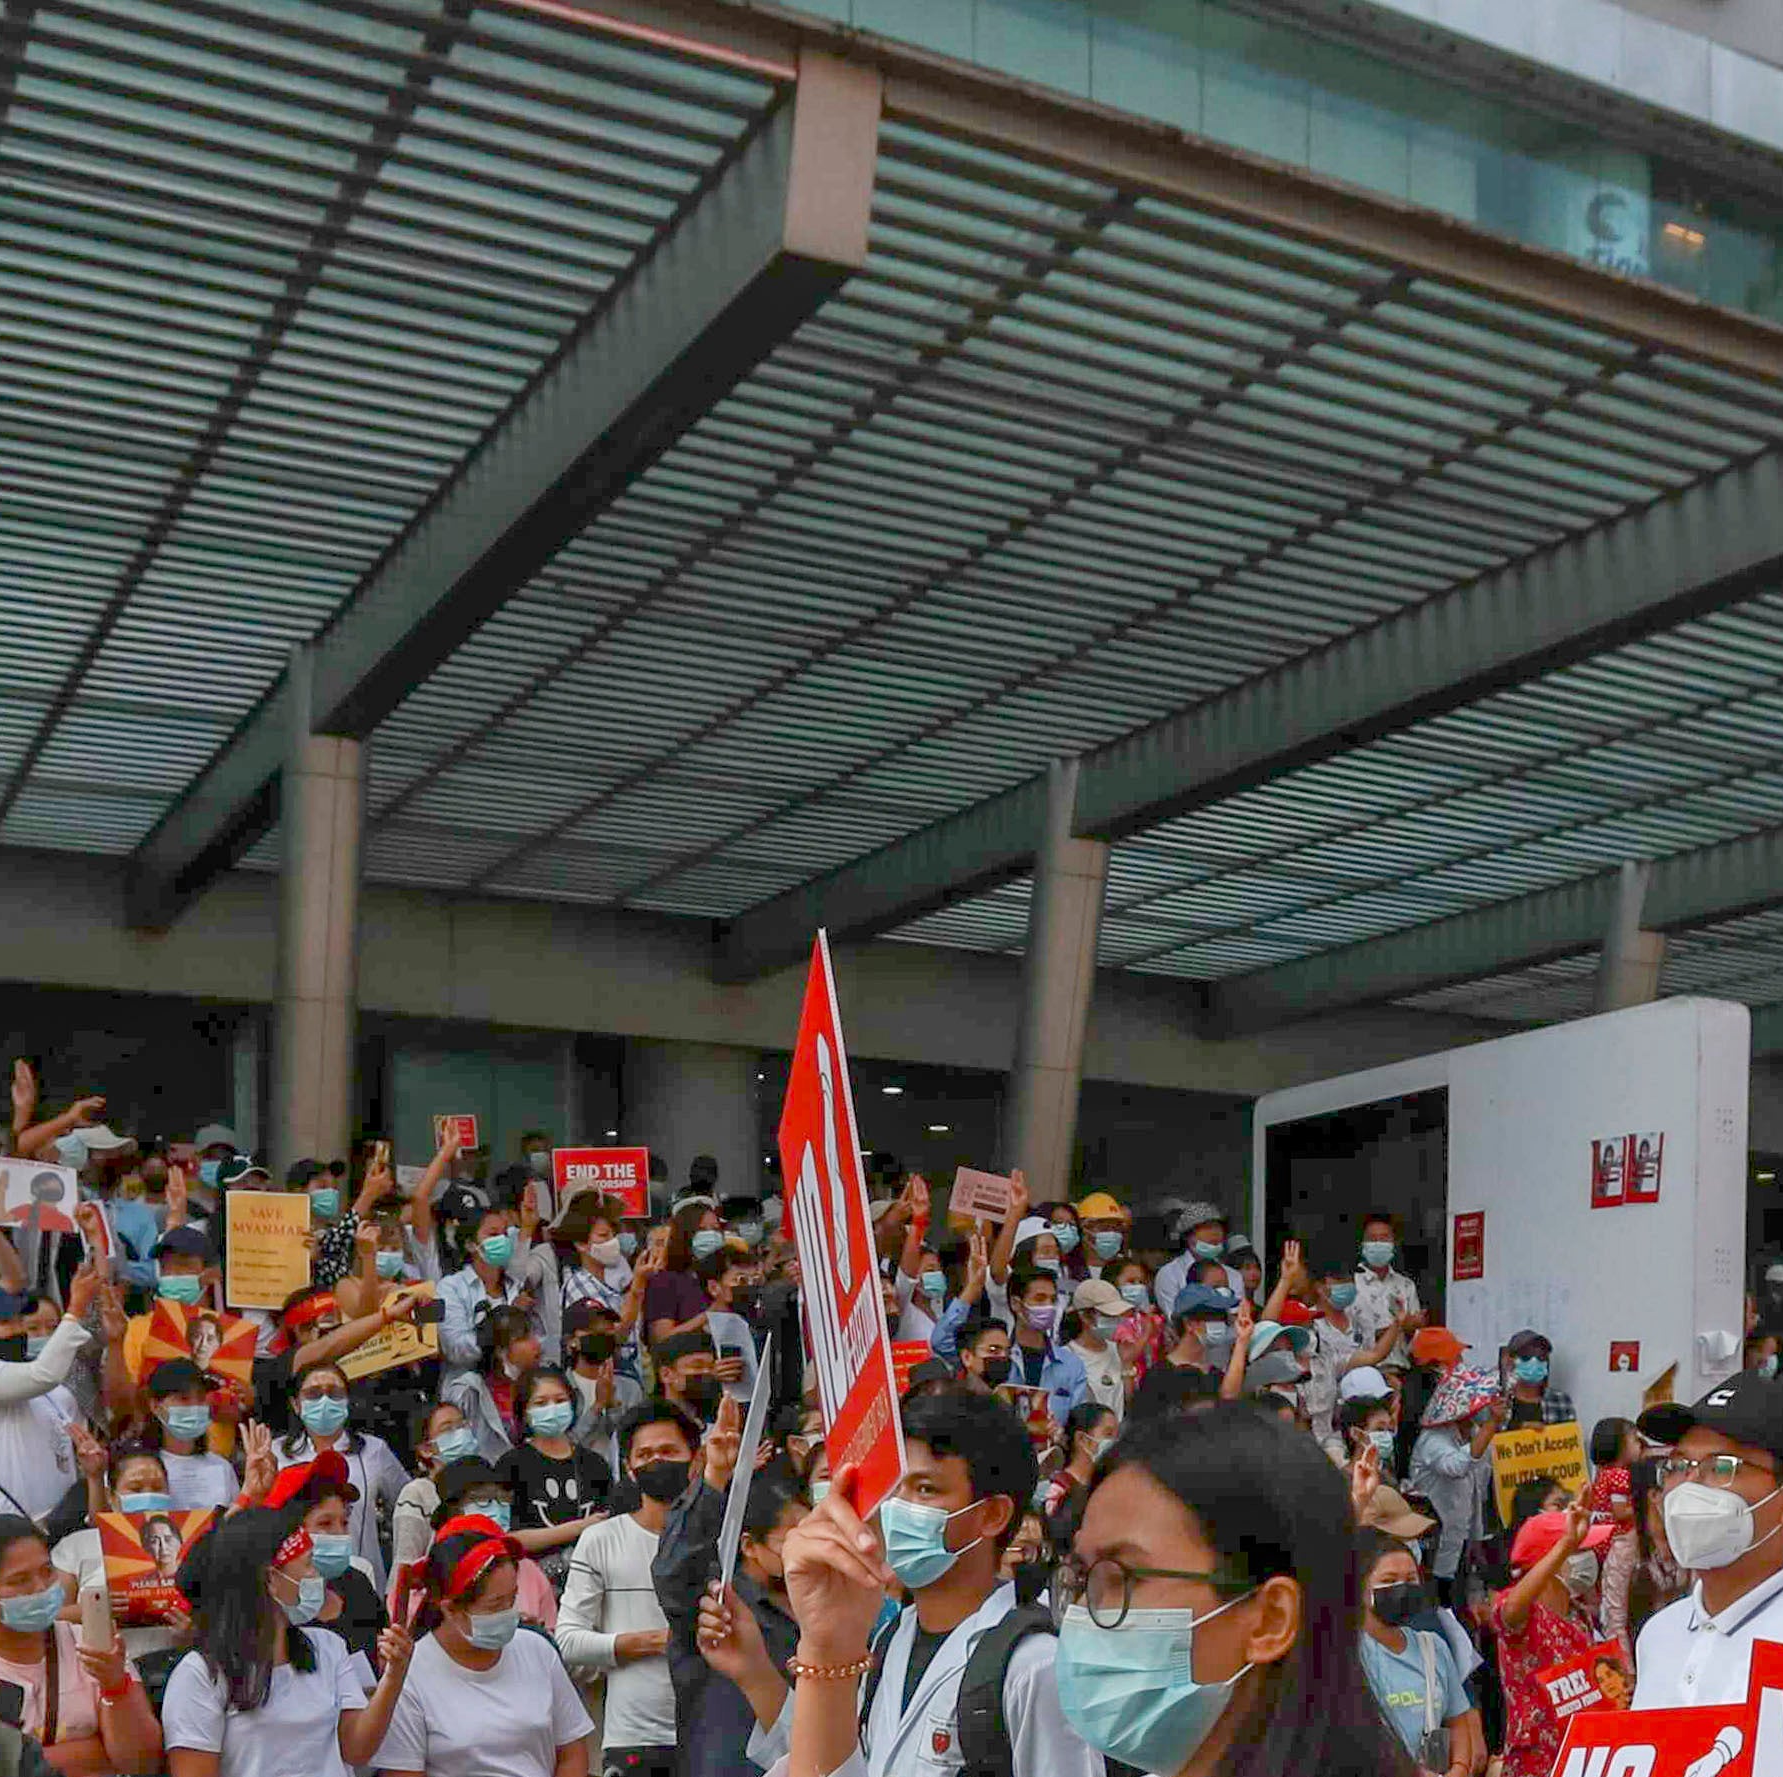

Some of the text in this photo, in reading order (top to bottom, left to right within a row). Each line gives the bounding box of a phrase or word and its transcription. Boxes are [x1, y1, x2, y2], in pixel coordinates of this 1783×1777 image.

[566, 1163, 636, 1180] END THE
[250, 1206, 283, 1219] SAVE
[1514, 1440, 1542, 1457] Don't
[1544, 1435, 1579, 1452] Accept
[1552, 1462, 1582, 1480] COUP
[1546, 1669, 1591, 1705] FREE
